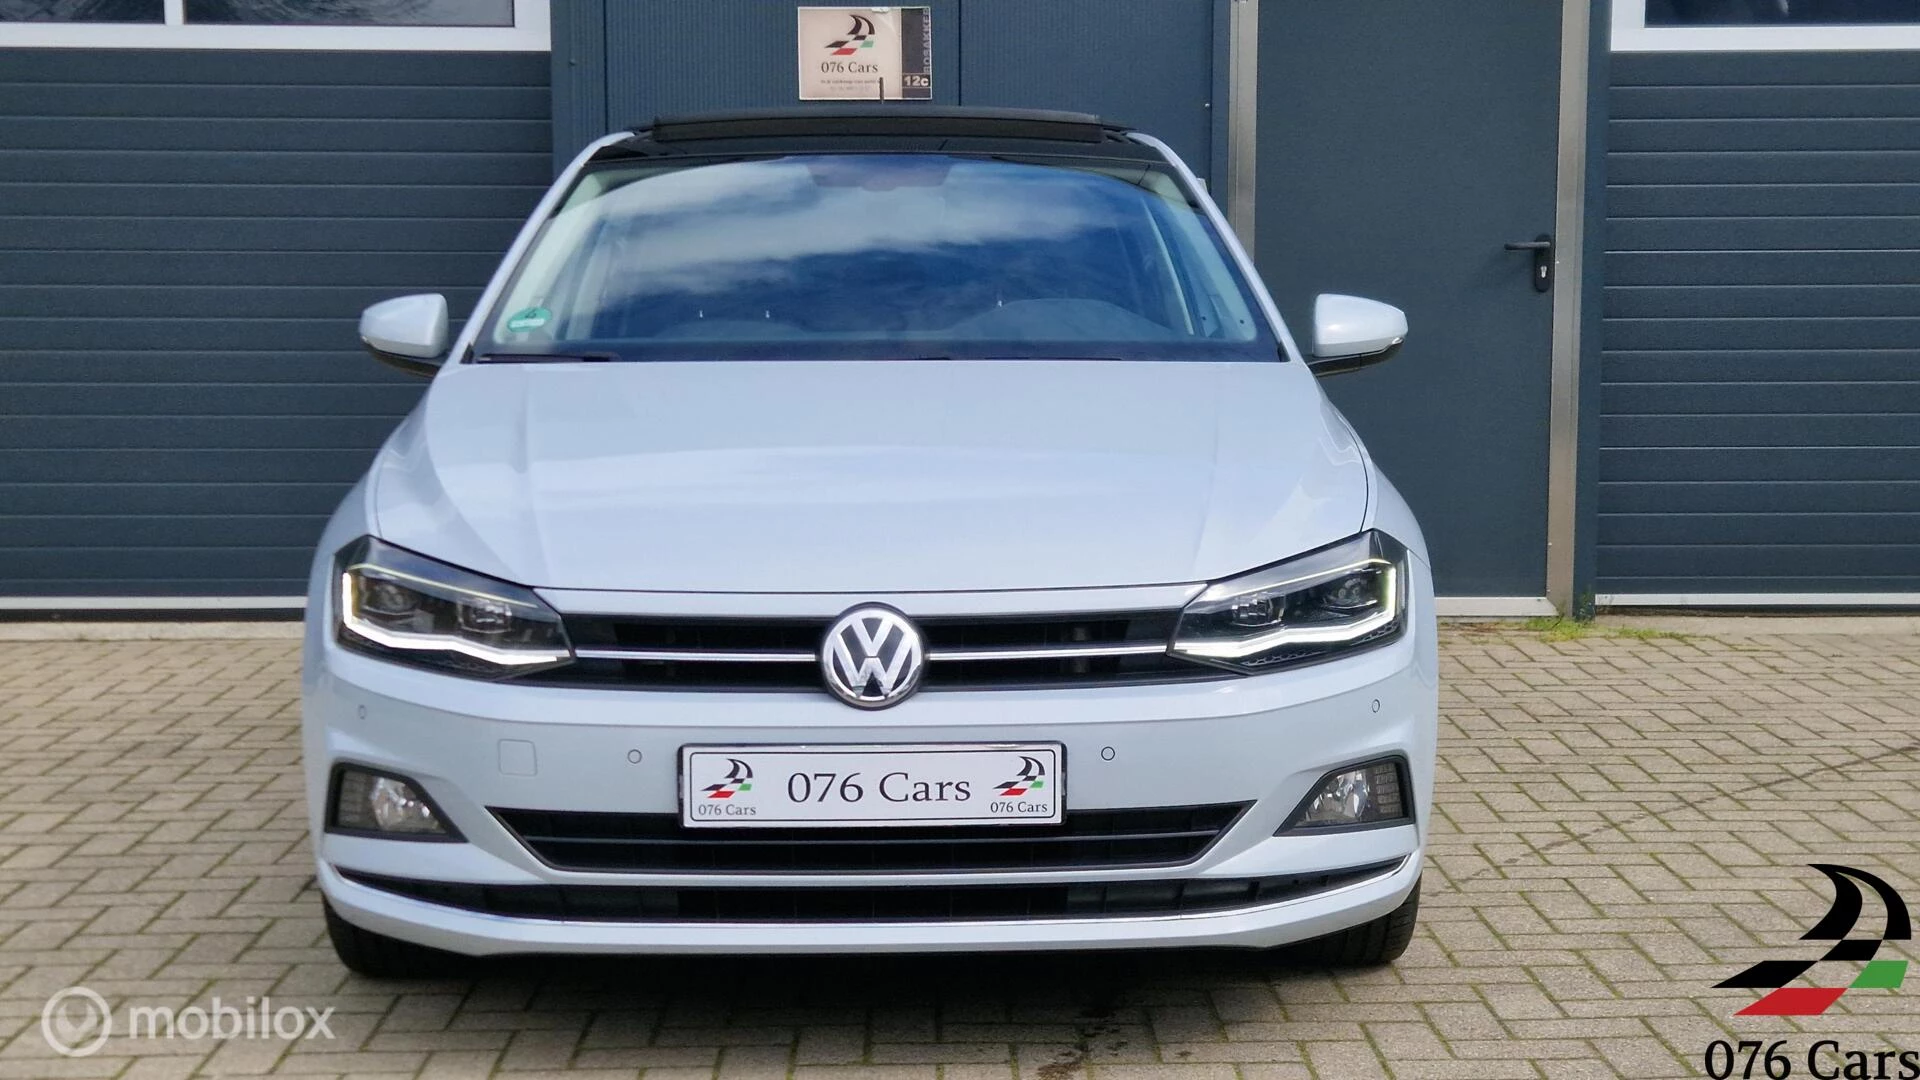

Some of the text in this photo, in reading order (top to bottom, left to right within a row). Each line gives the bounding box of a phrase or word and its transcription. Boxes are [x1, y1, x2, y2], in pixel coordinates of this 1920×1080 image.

[821, 61, 878, 73] 076 Cars
[904, 75, 929, 86] 12c
[787, 772, 971, 803] 076 Cars
[698, 804, 757, 816] 076 Cars
[990, 801, 1048, 813] 076 Cars
